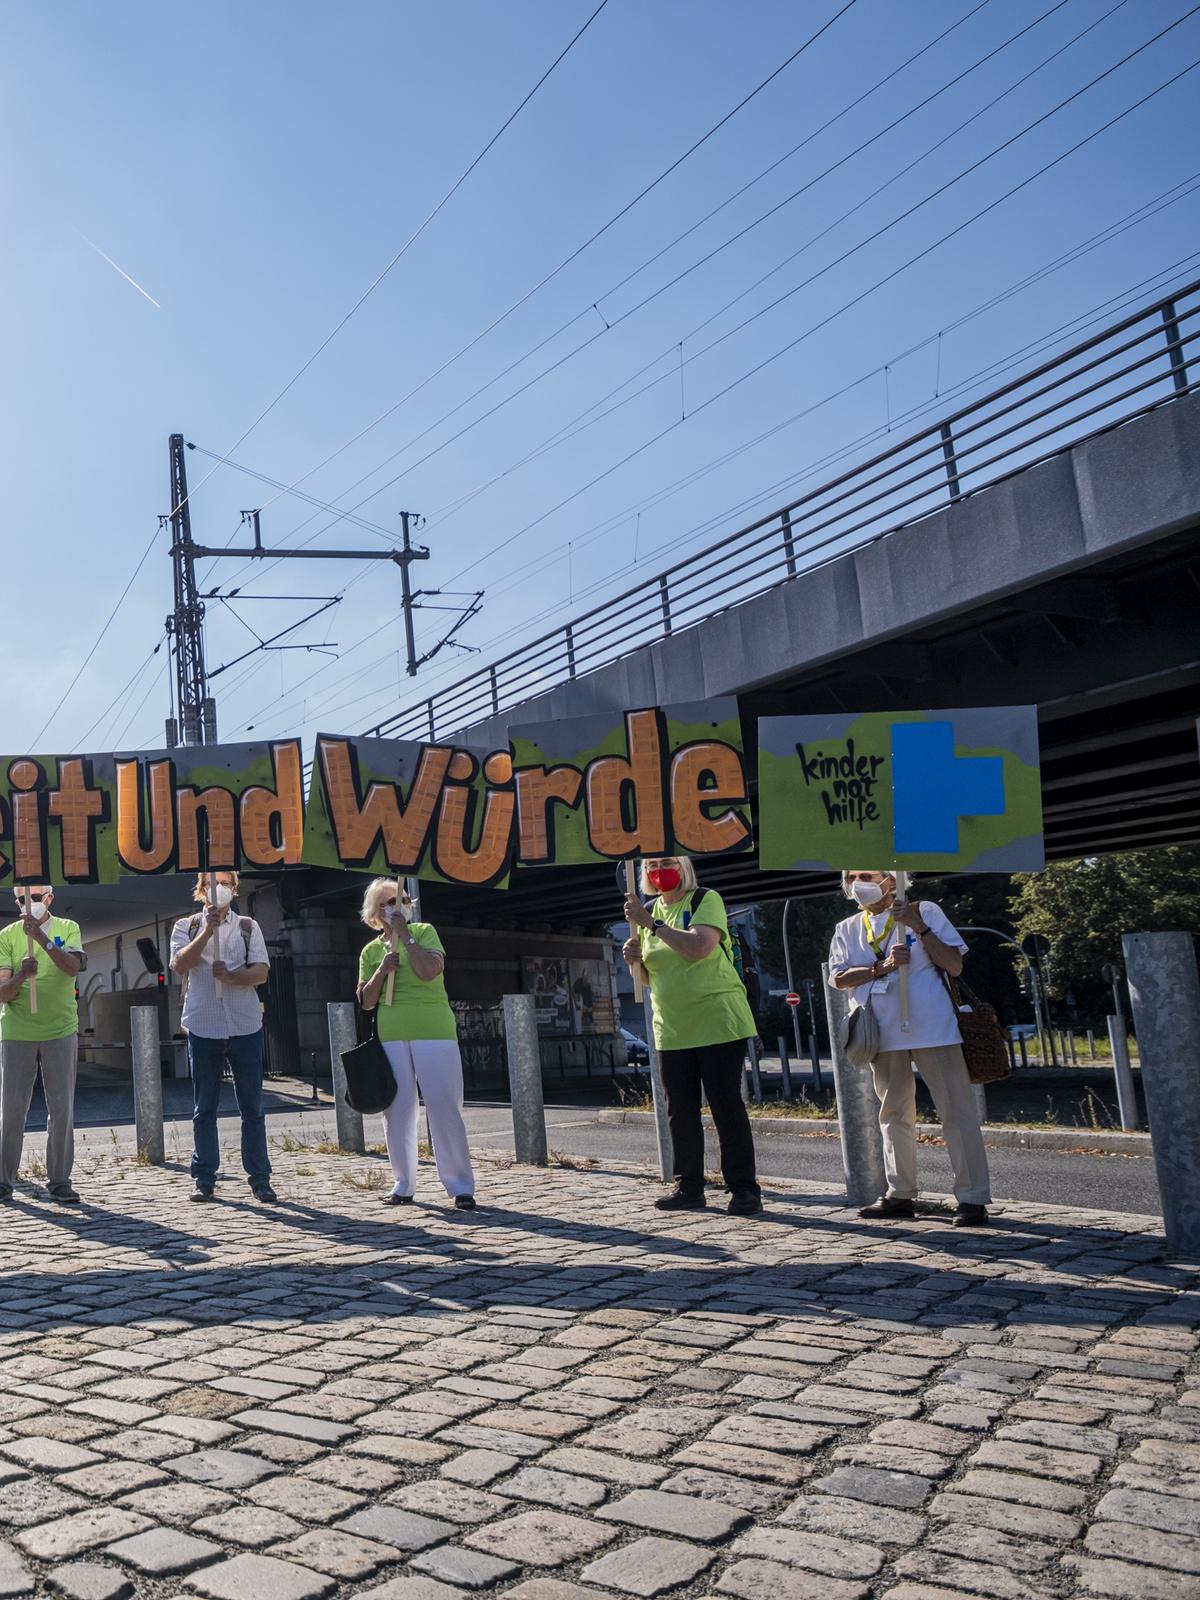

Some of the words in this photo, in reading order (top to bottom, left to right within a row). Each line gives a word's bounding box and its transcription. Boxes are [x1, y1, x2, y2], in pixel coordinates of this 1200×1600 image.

[795, 738, 885, 787] kinder
[833, 776, 878, 798] not
[821, 791, 880, 830] hilfe
